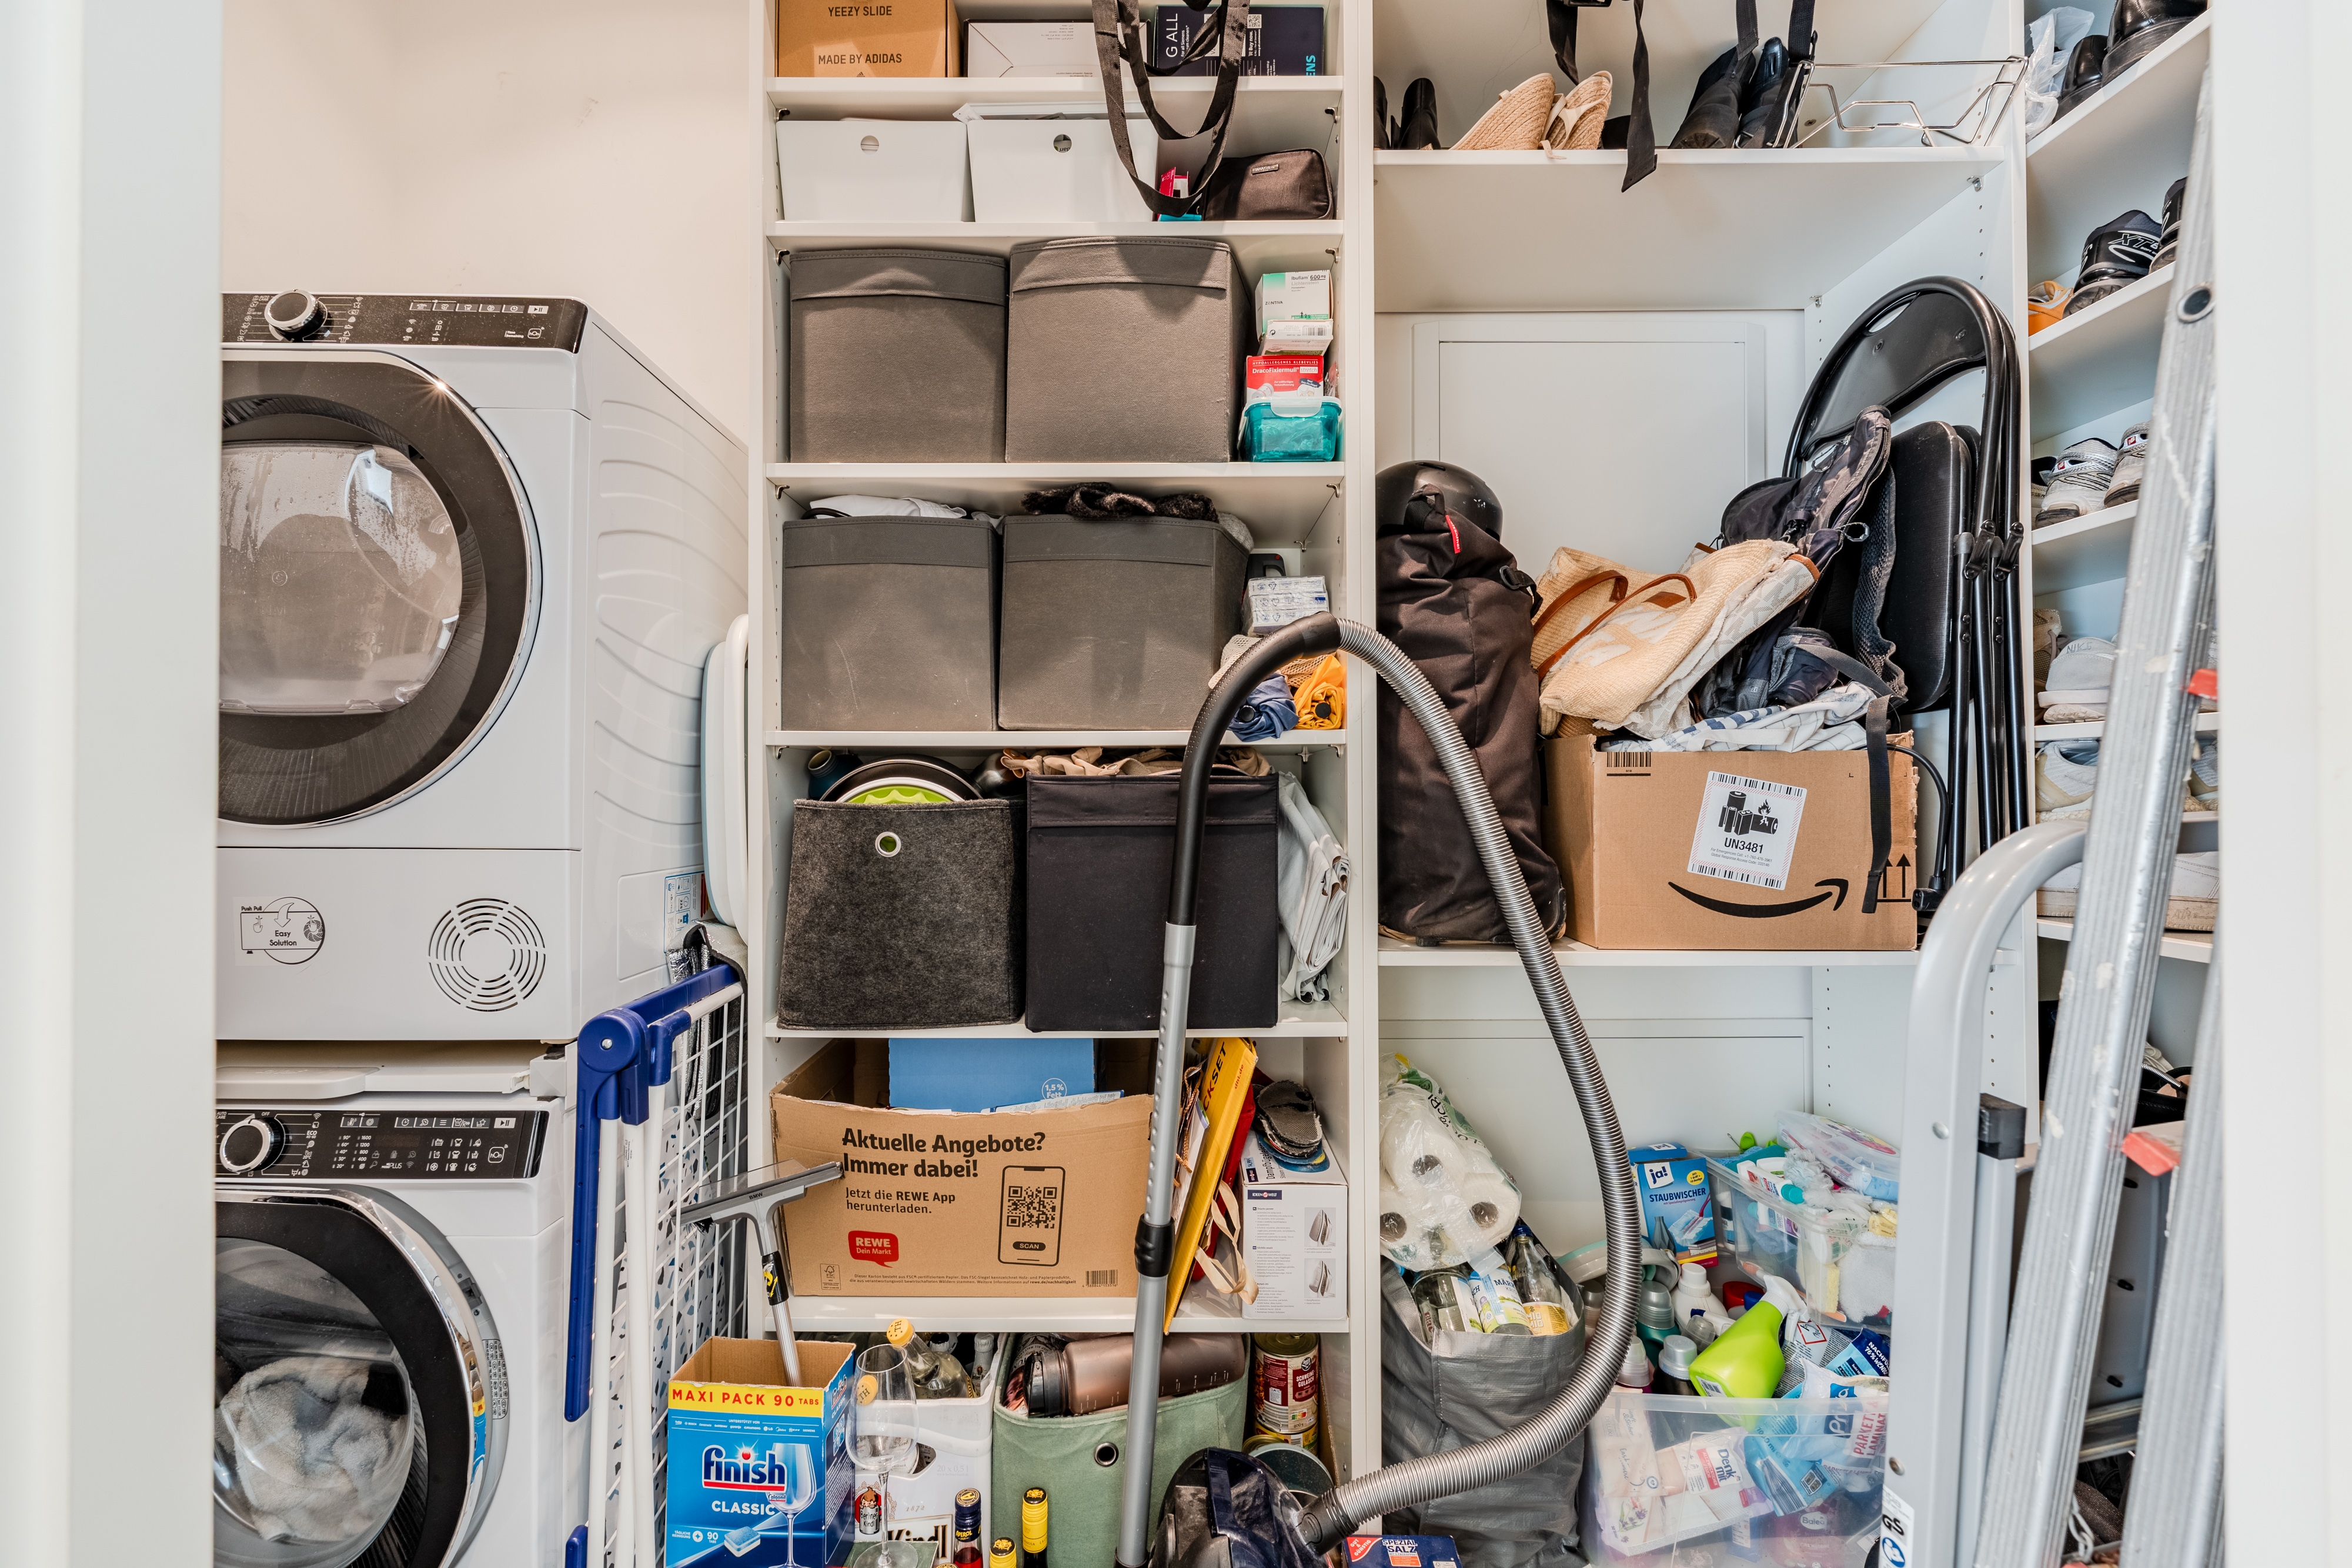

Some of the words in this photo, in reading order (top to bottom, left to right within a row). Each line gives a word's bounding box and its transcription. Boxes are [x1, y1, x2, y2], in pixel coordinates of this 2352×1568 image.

[828, 6, 860, 16] YEEZY
[863, 5, 893, 16] SLIDE
[1166, 14, 1178, 42] ALL
[818, 54, 846, 64] MADE
[849, 54, 862, 63] BY
[865, 54, 902, 63] ADIDAS
[1166, 46, 1178, 57] G
[1724, 837, 1763, 854] UN3481
[1235, 1064, 1244, 1089] dhl.de
[842, 1128, 927, 1153] Aktuelle
[932, 1132, 1046, 1158] Angebote?
[843, 1153, 908, 1176] Immer
[913, 1159, 979, 1178] dabei!
[1649, 1166, 1668, 1185] ja!
[846, 1186, 871, 1199] Jetzt
[874, 1189, 893, 1201] die
[896, 1191, 929, 1201] REWE
[932, 1192, 956, 1204] App
[1649, 1188, 1706, 1202] STAUBWISCHER
[846, 1199, 933, 1214] herunterladen.
[856, 1236, 891, 1248] REWE
[1526, 1312, 1542, 1320] MIO
[894, 1319, 902, 1332] TH
[1530, 1320, 1544, 1328] MIO
[1865, 1346, 1876, 1360] 76%
[1296, 1370, 1315, 1382] SCHWEINE-
[1298, 1376, 1315, 1388] GULASCH
[672, 1389, 713, 1402] MAXI
[722, 1392, 765, 1405] PACK
[774, 1395, 794, 1406] 90
[831, 1375, 847, 1407] finish
[858, 1388, 870, 1400] TH
[1605, 1416, 1613, 1438] DELUXE
[703, 1445, 786, 1486] finish
[937, 1465, 946, 1473] 20
[953, 1465, 964, 1473] 0,5
[1703, 1464, 1712, 1479] FEUCHT
[1718, 1449, 1736, 1479] Denk
[1715, 1466, 1728, 1482] mit
[711, 1500, 776, 1515] CLASSIC
[860, 1510, 878, 1520] Berliner
[1802, 1516, 1825, 1525] Balea
[1882, 1514, 1905, 1536] GS
[707, 1531, 719, 1540] 90
[1349, 1538, 1359, 1547] GUT
[1354, 1539, 1372, 1556] GÜNSTIG
